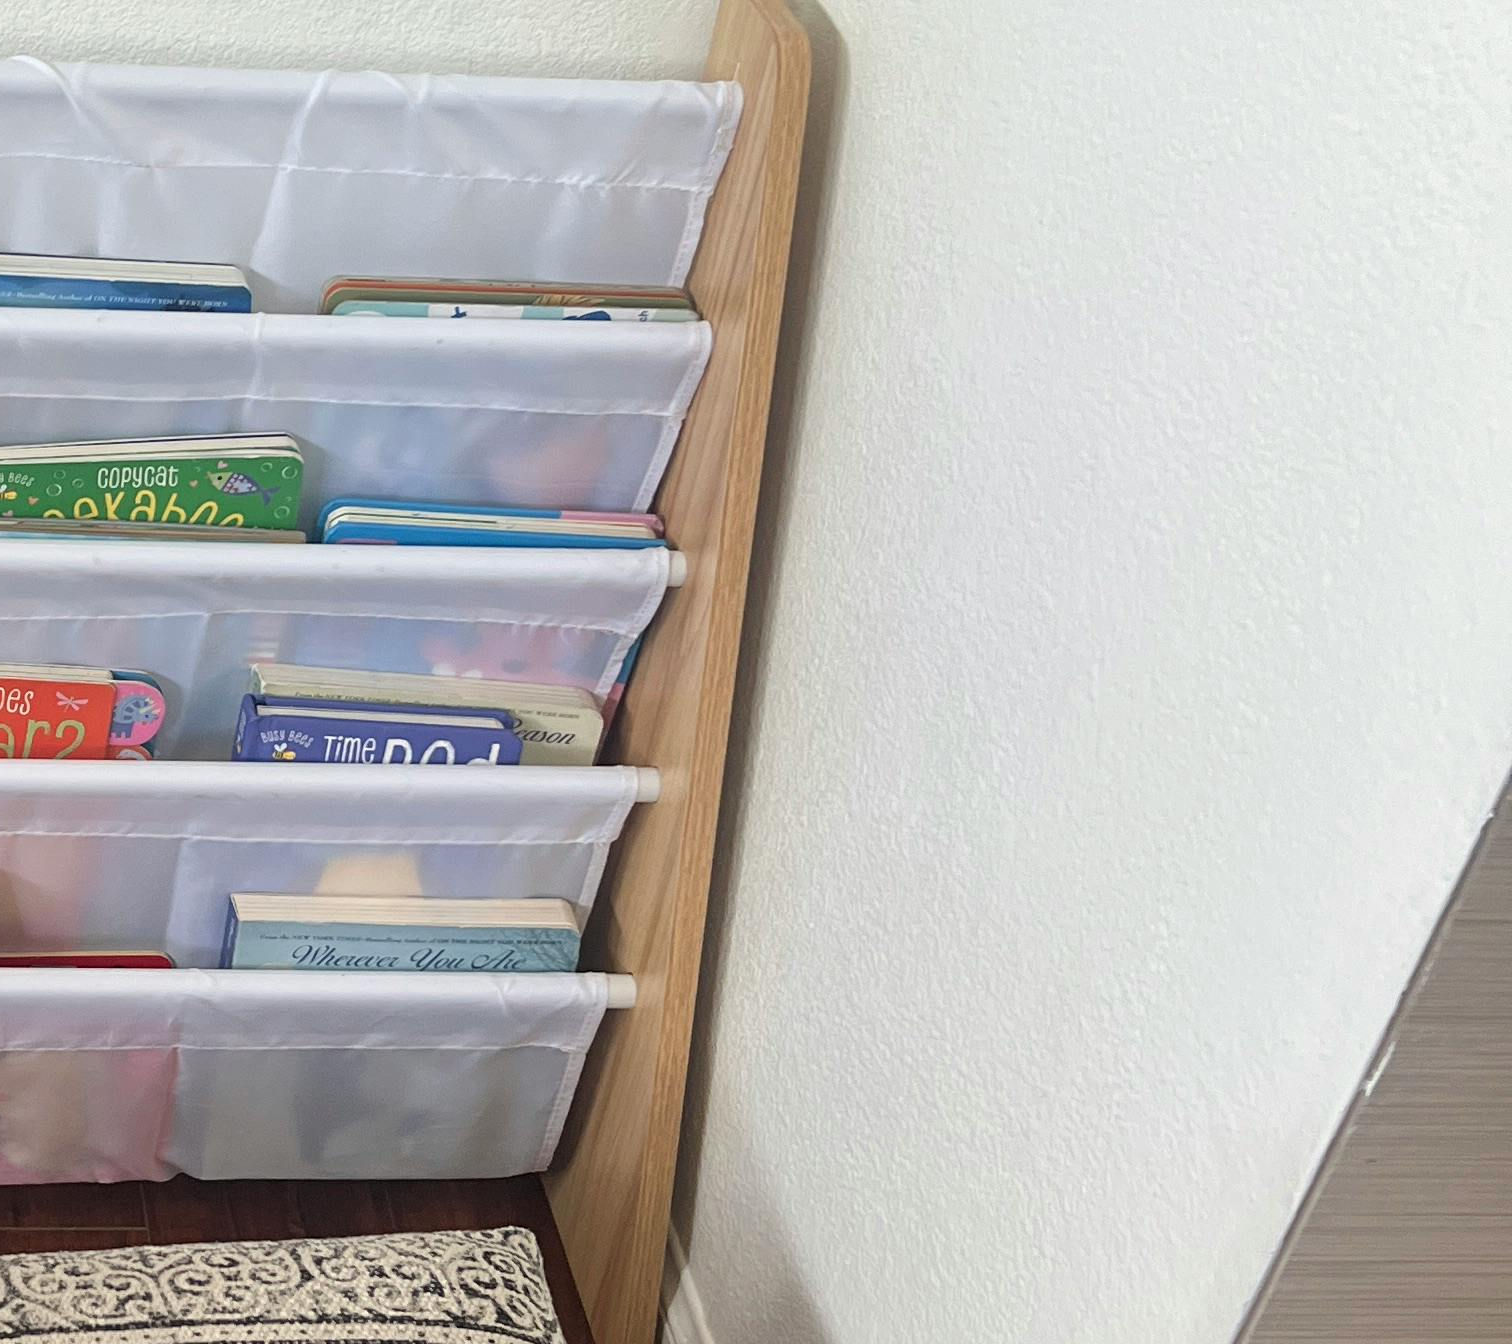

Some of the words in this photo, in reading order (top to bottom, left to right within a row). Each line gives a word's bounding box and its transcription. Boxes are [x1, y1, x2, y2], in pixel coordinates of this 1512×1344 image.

[292, 944, 400, 968] Wherever
[409, 947, 465, 972] You
[471, 949, 526, 970] Are
